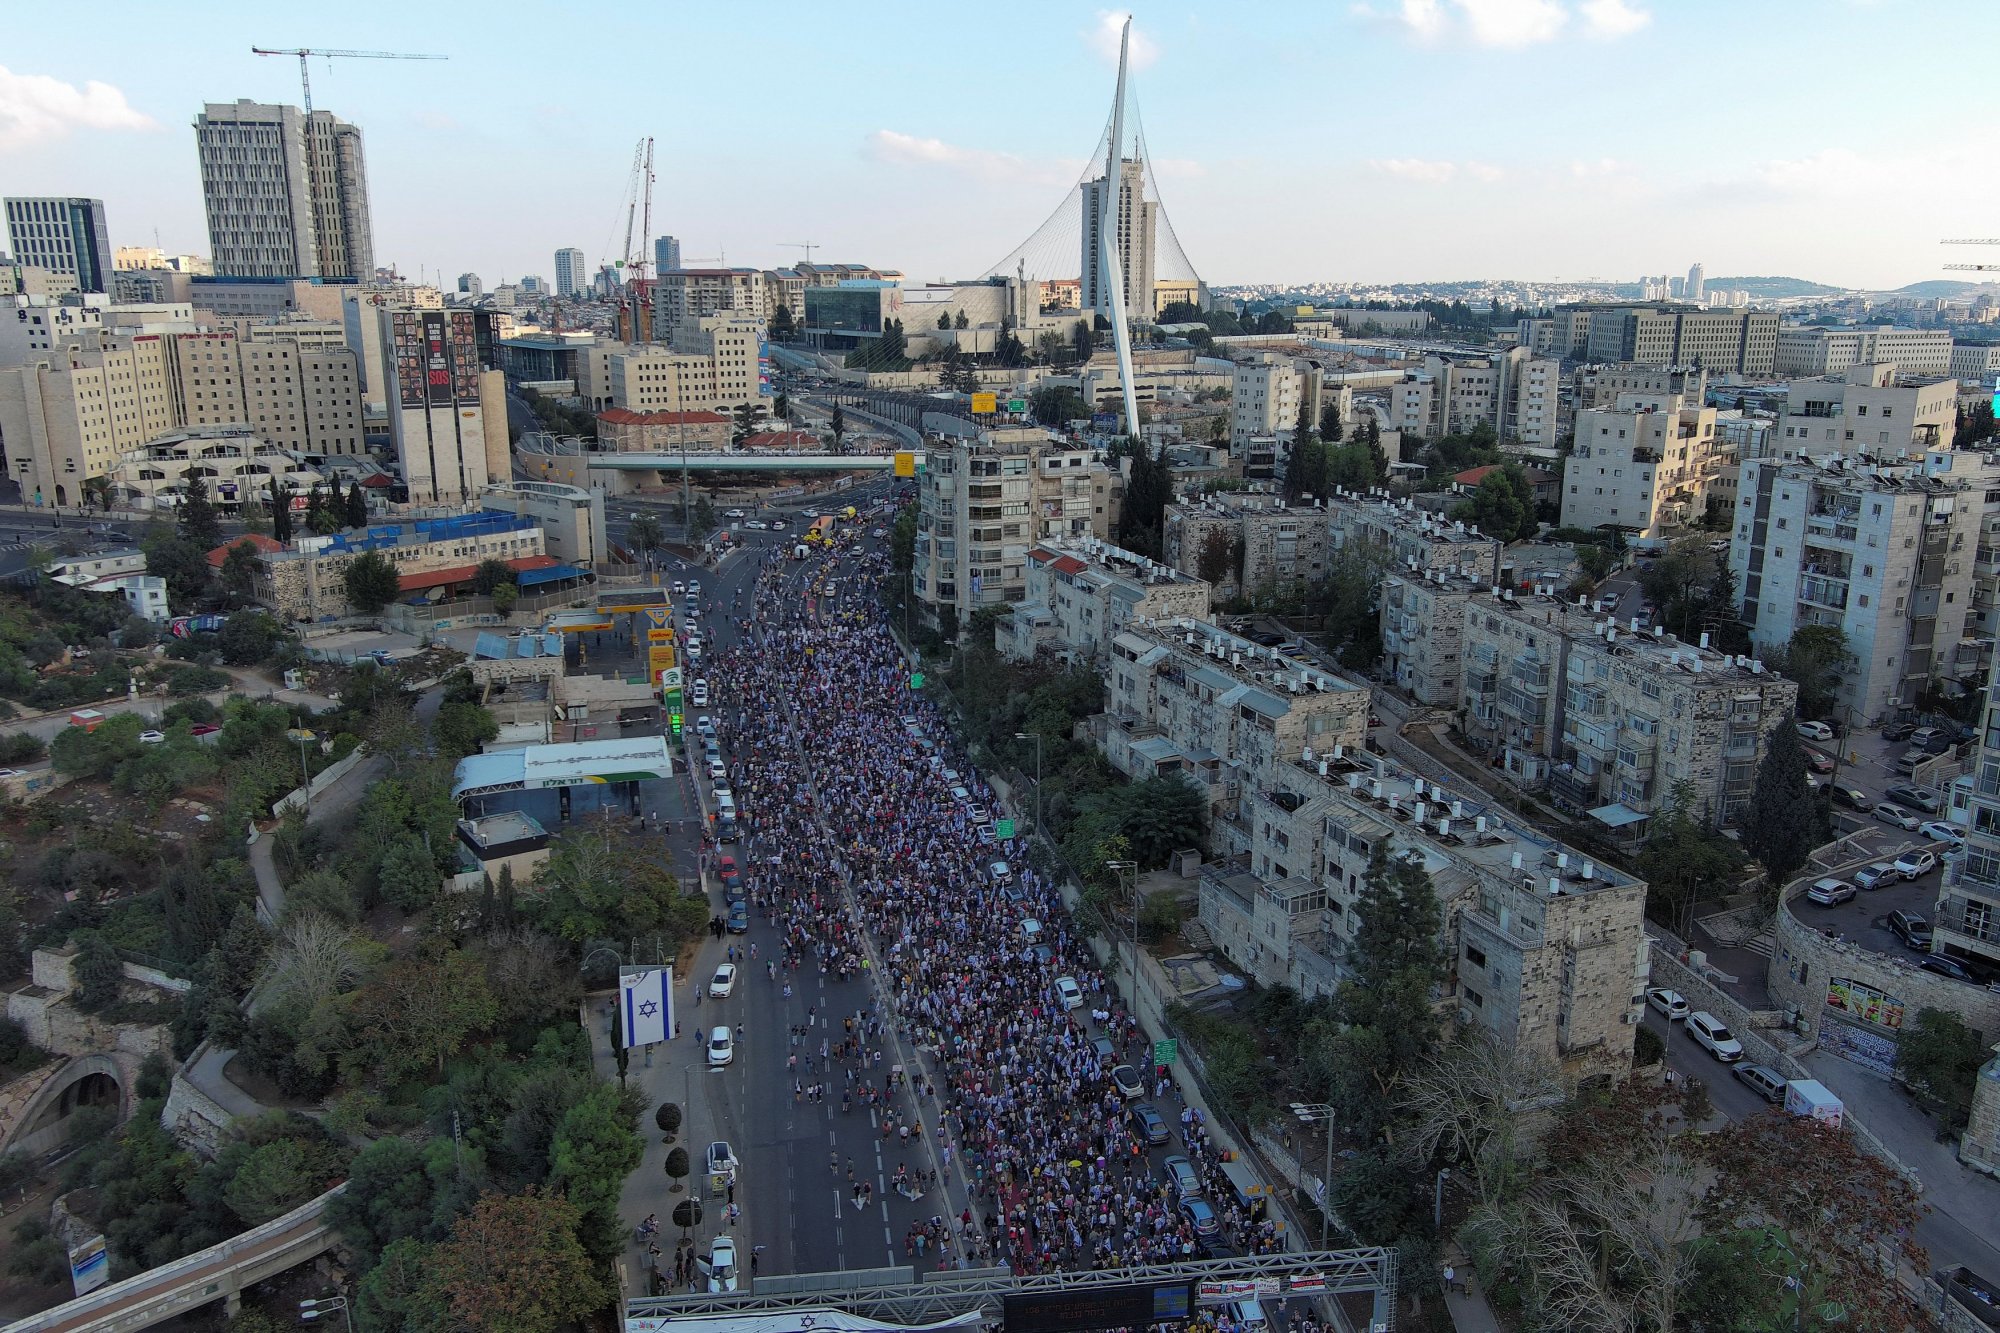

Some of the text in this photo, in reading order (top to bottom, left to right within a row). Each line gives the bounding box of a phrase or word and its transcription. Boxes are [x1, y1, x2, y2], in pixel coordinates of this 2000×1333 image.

[429, 370, 449, 384] SOS
[542, 779, 566, 787] אלון
[1060, 1308, 1104, 1319] ביחד ננצח
